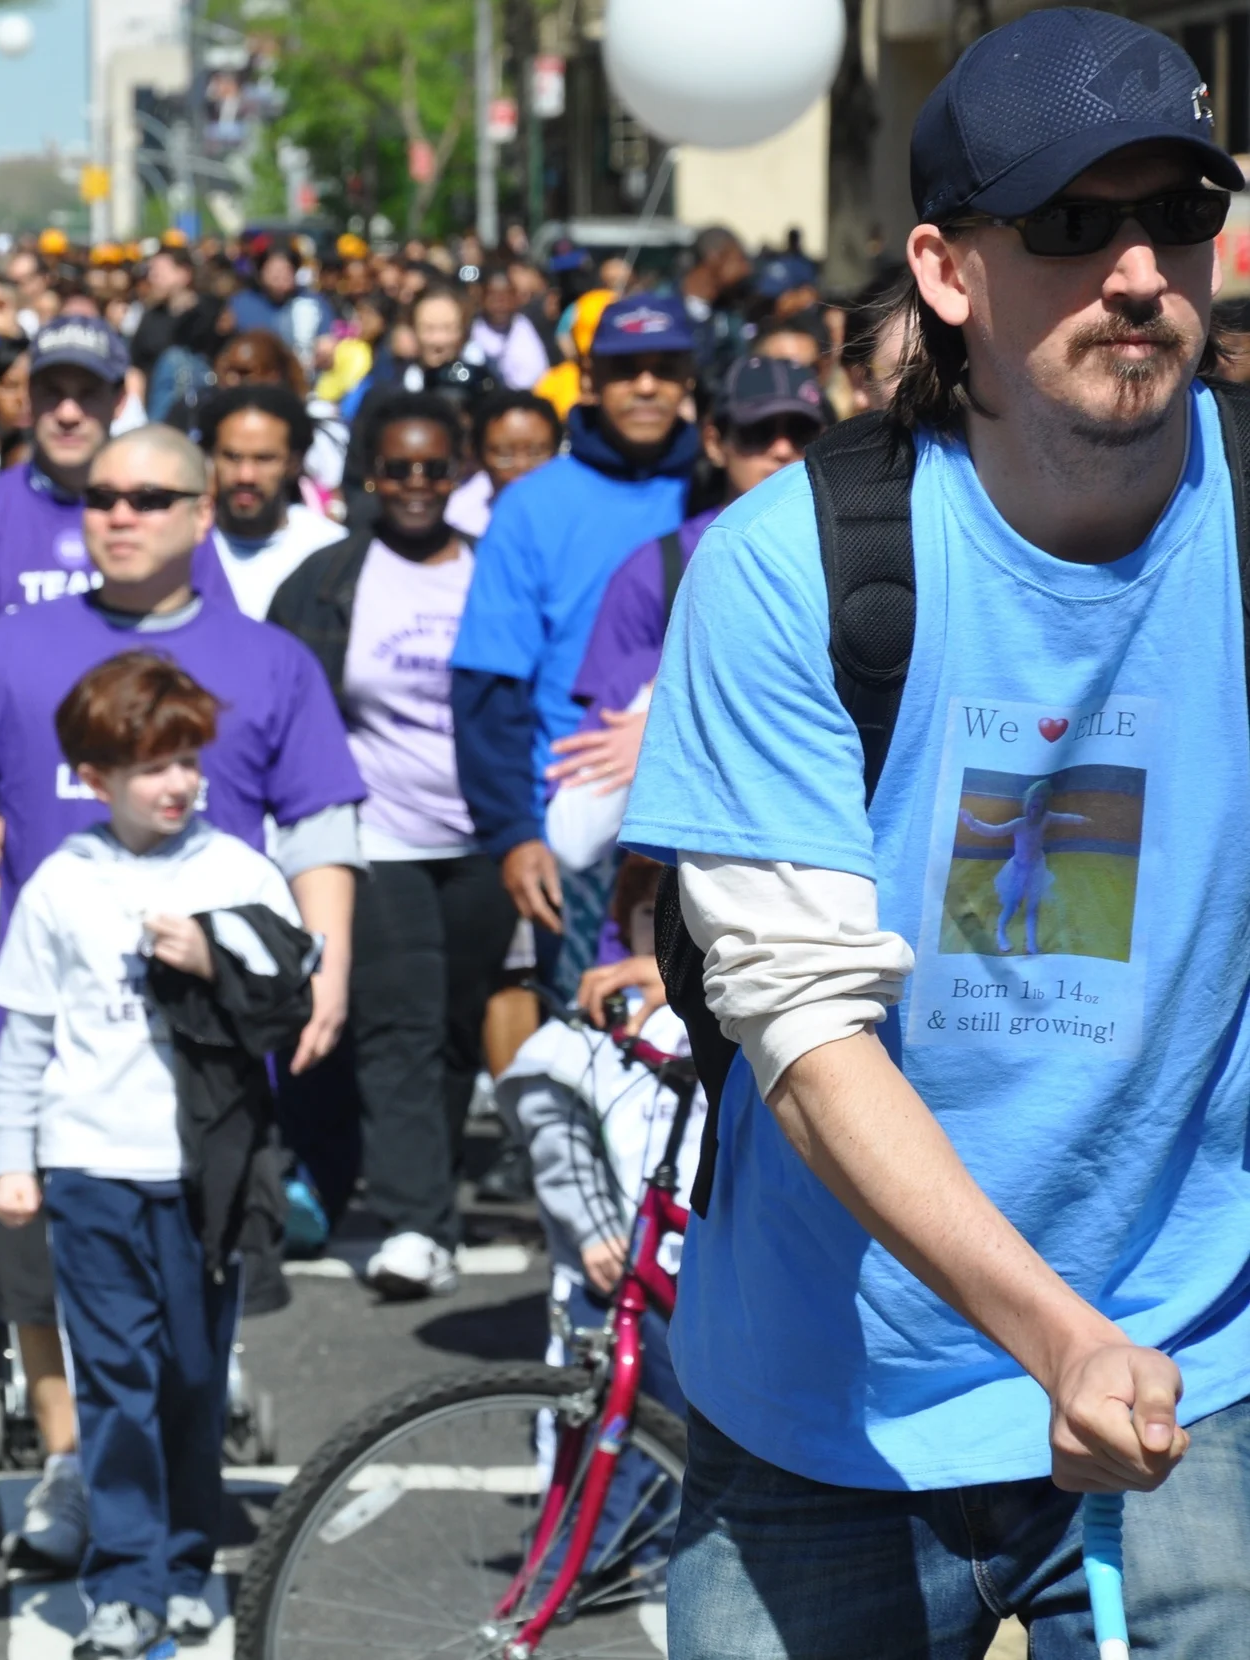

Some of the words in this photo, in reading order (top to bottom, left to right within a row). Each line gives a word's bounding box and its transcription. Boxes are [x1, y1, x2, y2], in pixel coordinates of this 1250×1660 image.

[962, 706, 1019, 743] We
[951, 978, 1009, 999] Born
[927, 1010, 947, 1030] &
[957, 1012, 1001, 1032] still
[1009, 1015, 1115, 1044] growing!
